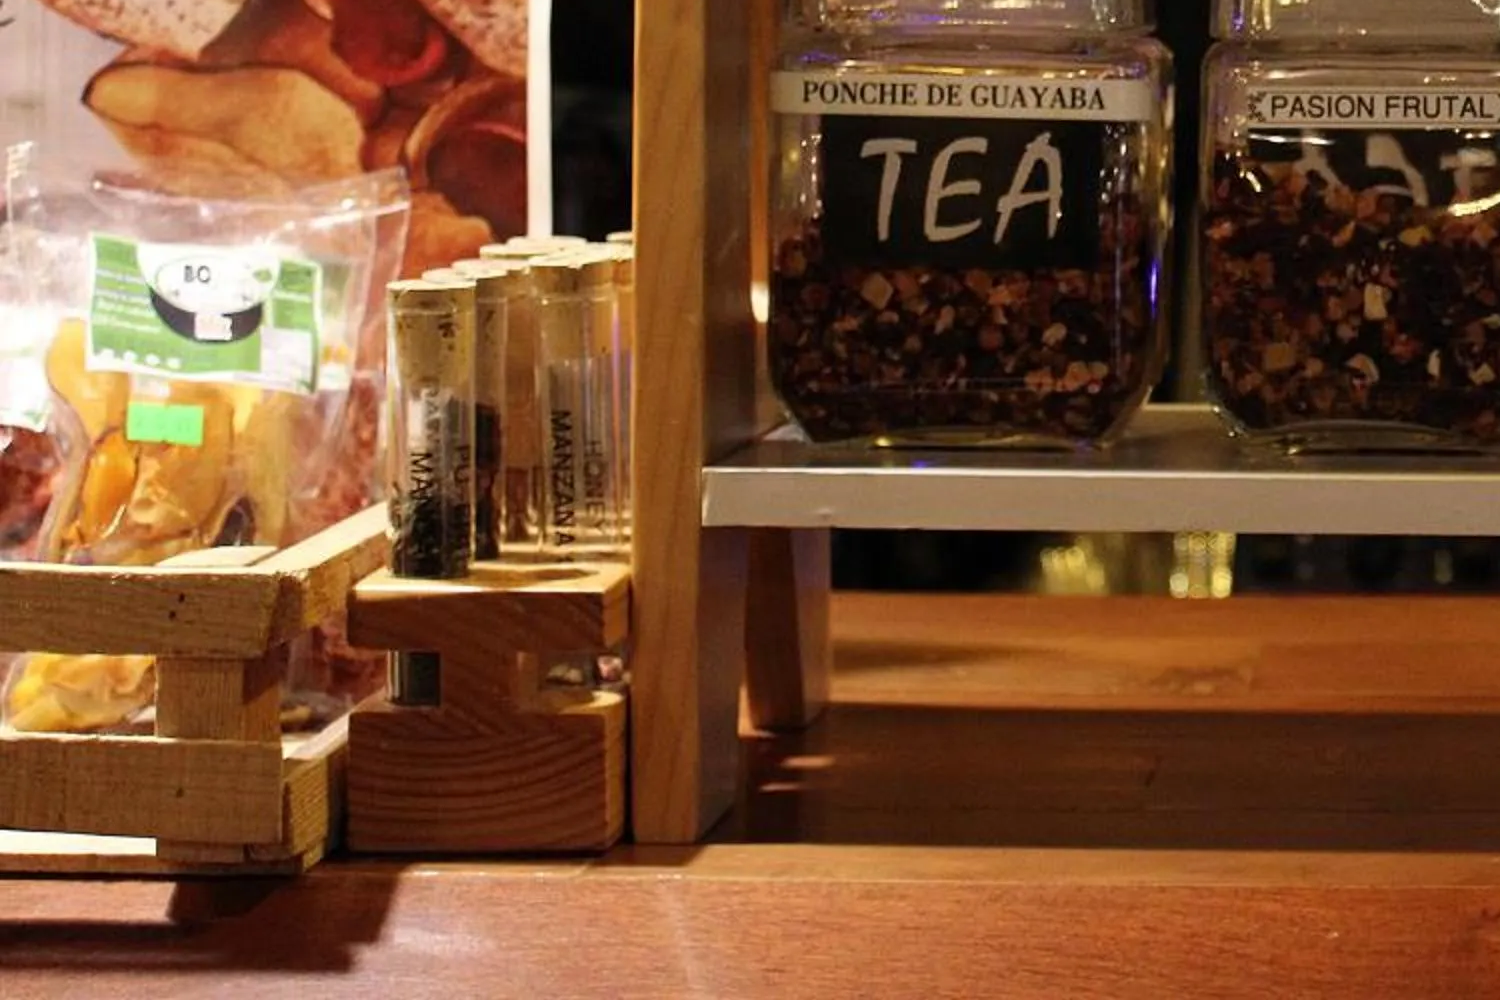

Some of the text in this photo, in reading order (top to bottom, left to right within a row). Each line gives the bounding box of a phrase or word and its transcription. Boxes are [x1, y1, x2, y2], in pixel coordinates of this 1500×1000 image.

[802, 80, 1106, 111] PONCHE DE GUAYABA
[1270, 95, 1495, 119] PASION FRUTAL
[860, 131, 1064, 245] TEA
